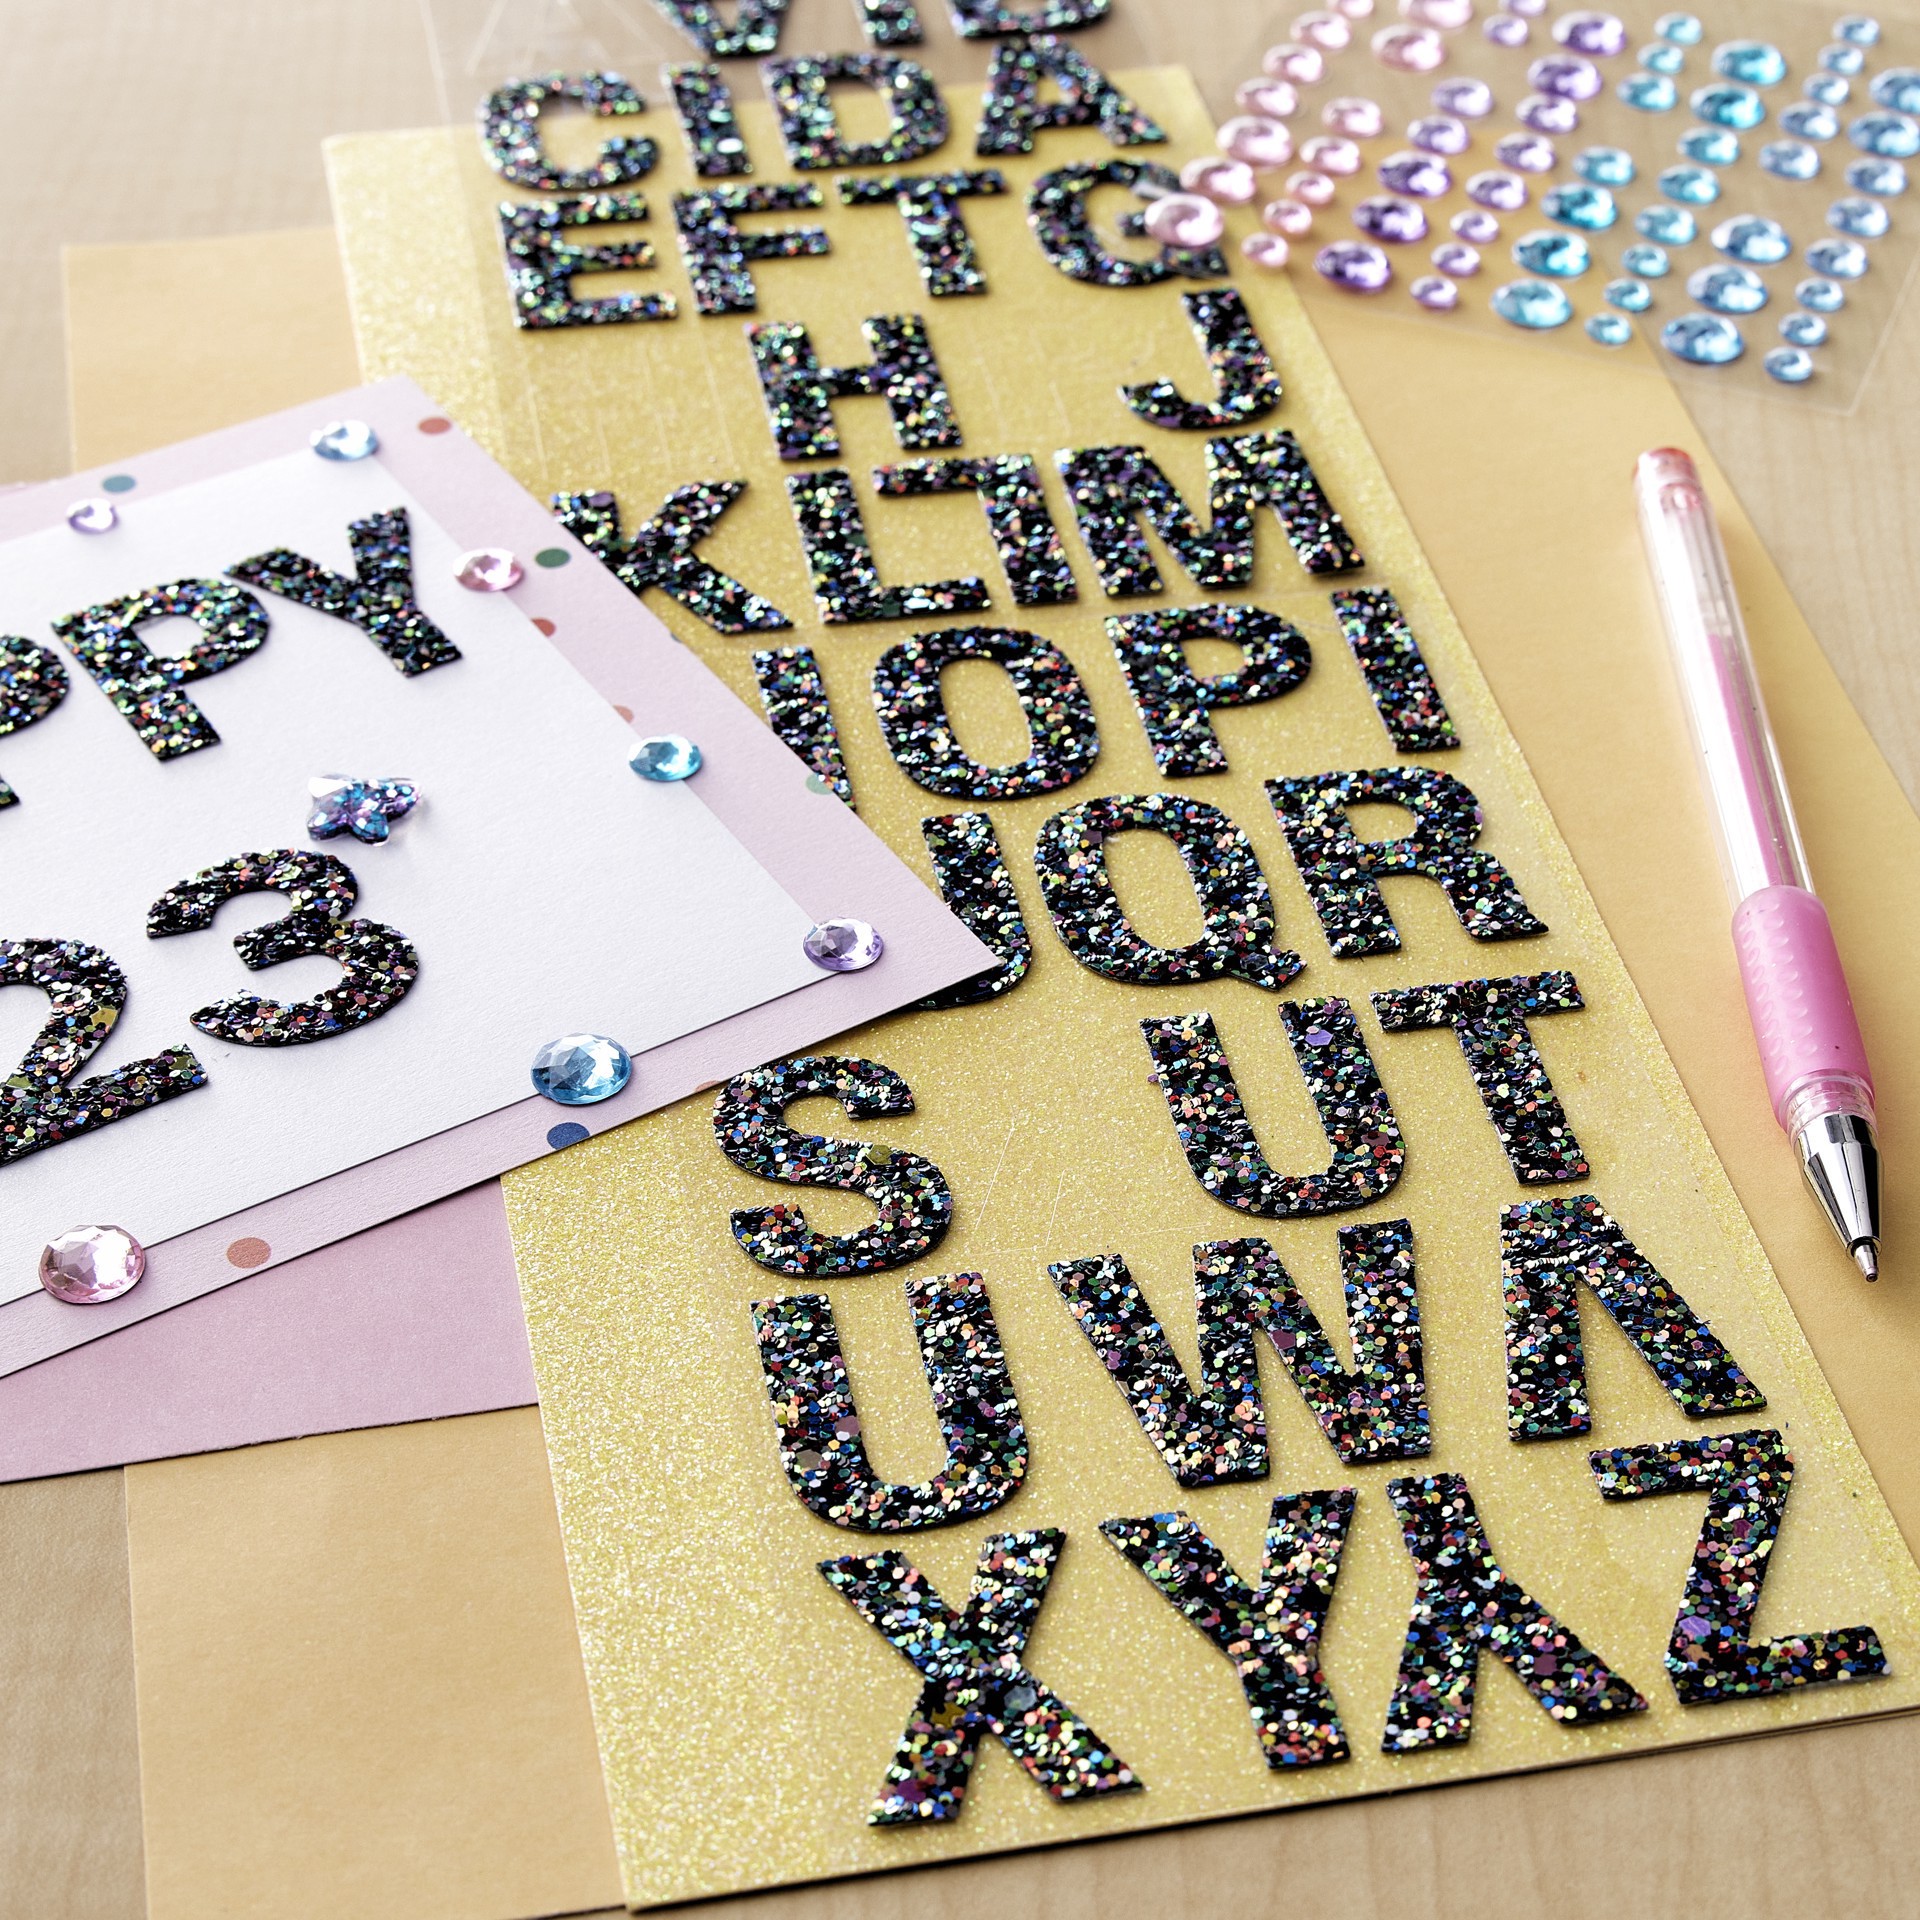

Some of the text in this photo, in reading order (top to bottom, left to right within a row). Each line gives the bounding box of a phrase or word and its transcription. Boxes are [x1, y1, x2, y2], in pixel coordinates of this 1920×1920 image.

[476, 69, 659, 191] C
[758, 53, 949, 170] D
[976, 35, 1168, 155] A
[497, 191, 679, 331] E
[672, 181, 831, 315] F
[836, 169, 1009, 297] T
[745, 288, 1282, 462] H J
[553, 480, 793, 635] K
[786, 468, 991, 625] L
[1053, 428, 1365, 598] M
[871, 624, 1100, 800] O
[1104, 603, 1312, 778] P
[1332, 586, 1460, 752] I
[1033, 792, 1308, 991] Q
[1263, 765, 1550, 959] R
[712, 969, 1585, 1278] S U T
[750, 1271, 1030, 1535] U
[1047, 1218, 1432, 1488] W
[816, 1527, 1146, 1827] X
[1098, 1487, 1358, 1772] Y
[1588, 1428, 1894, 1706] Z
